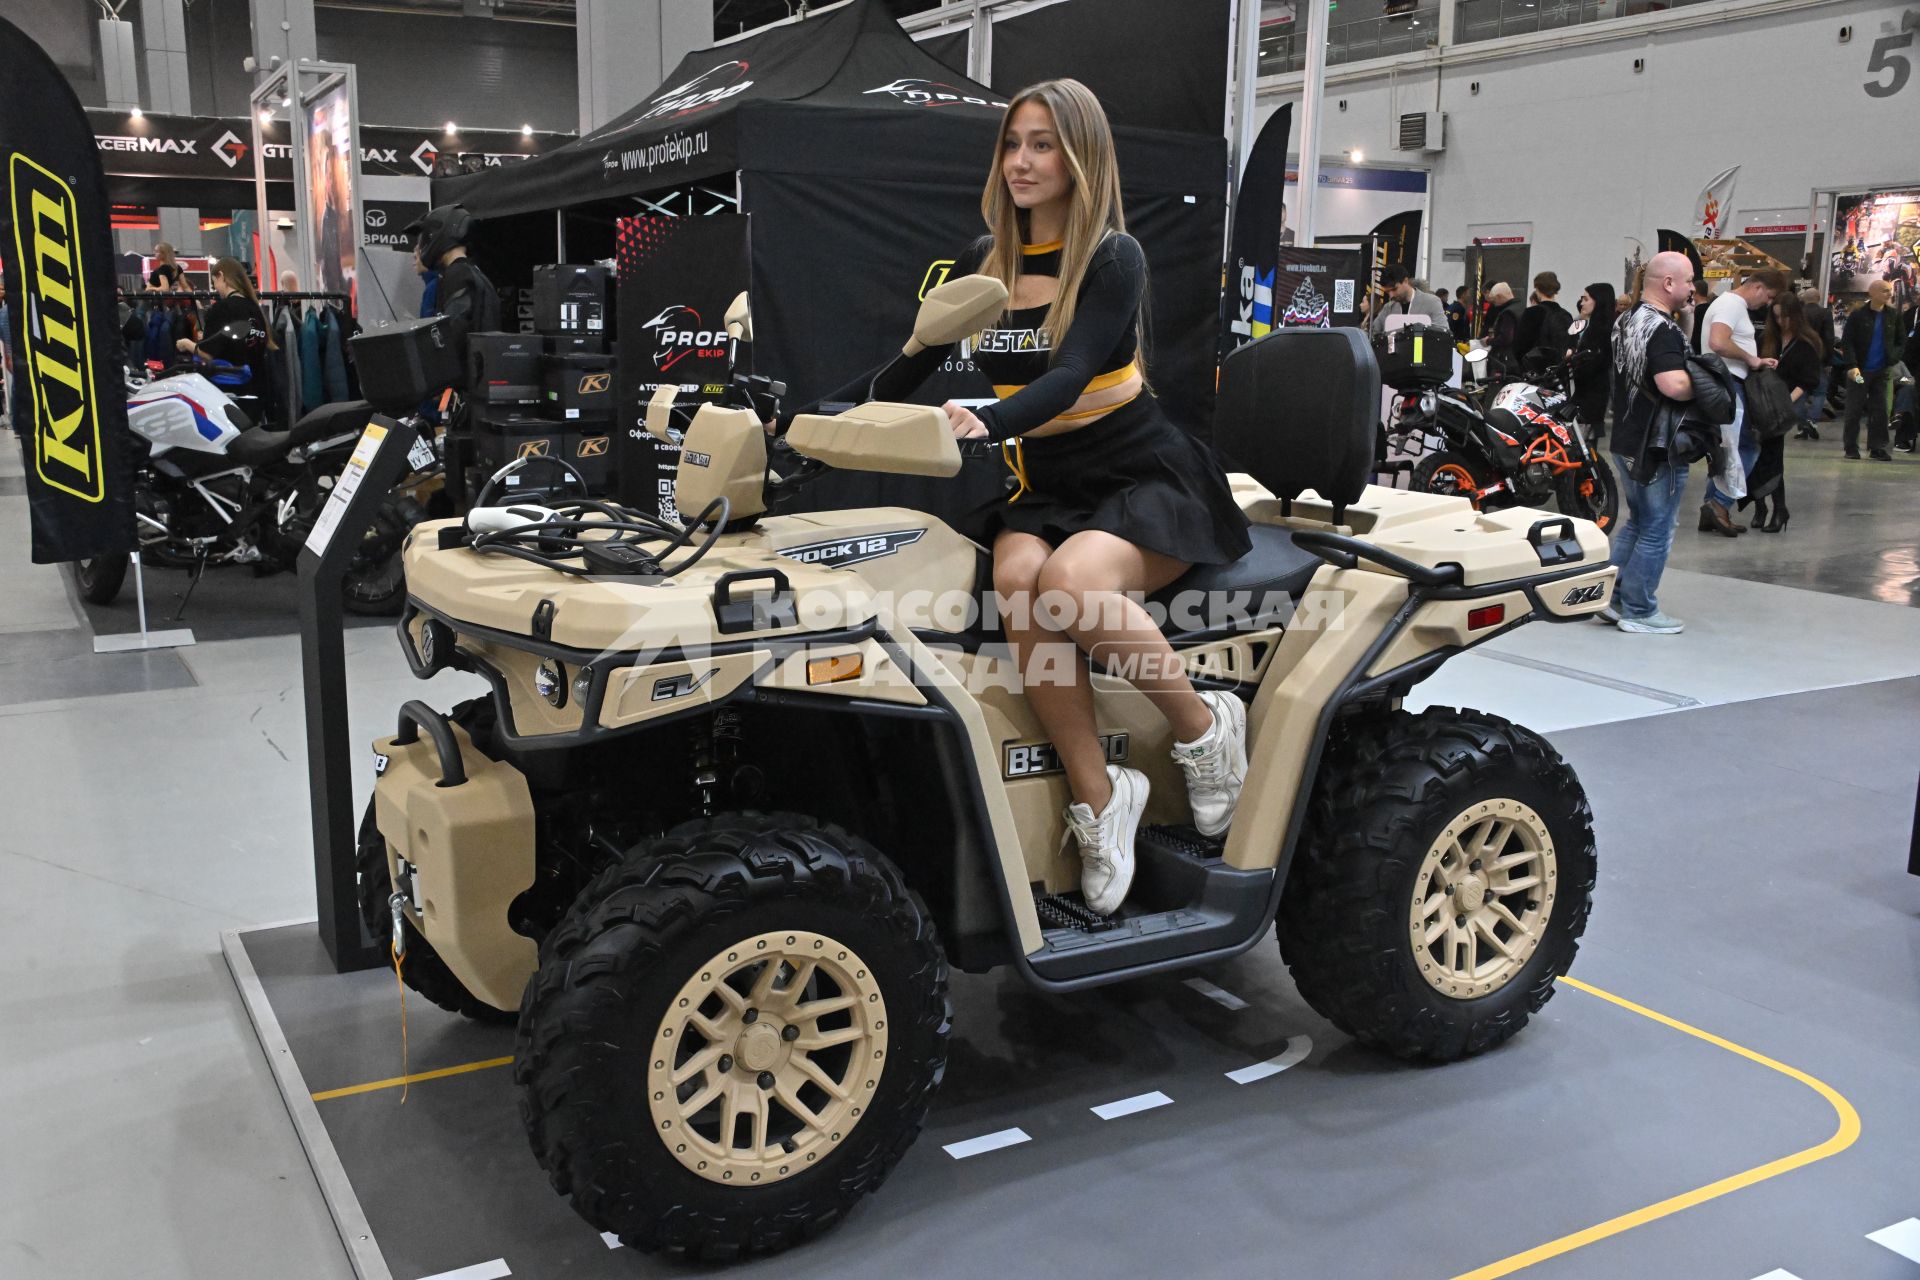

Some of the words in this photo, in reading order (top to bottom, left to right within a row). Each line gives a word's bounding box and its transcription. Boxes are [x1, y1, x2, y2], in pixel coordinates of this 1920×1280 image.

[1863, 32, 1913, 98] 5
[621, 130, 708, 173] www.profekip.ru
[364, 234, 409, 244] ВРИДА
[1231, 245, 1256, 343] ka
[661, 331, 729, 346] PROF
[697, 349, 725, 358] EKIP
[856, 537, 887, 555] 12
